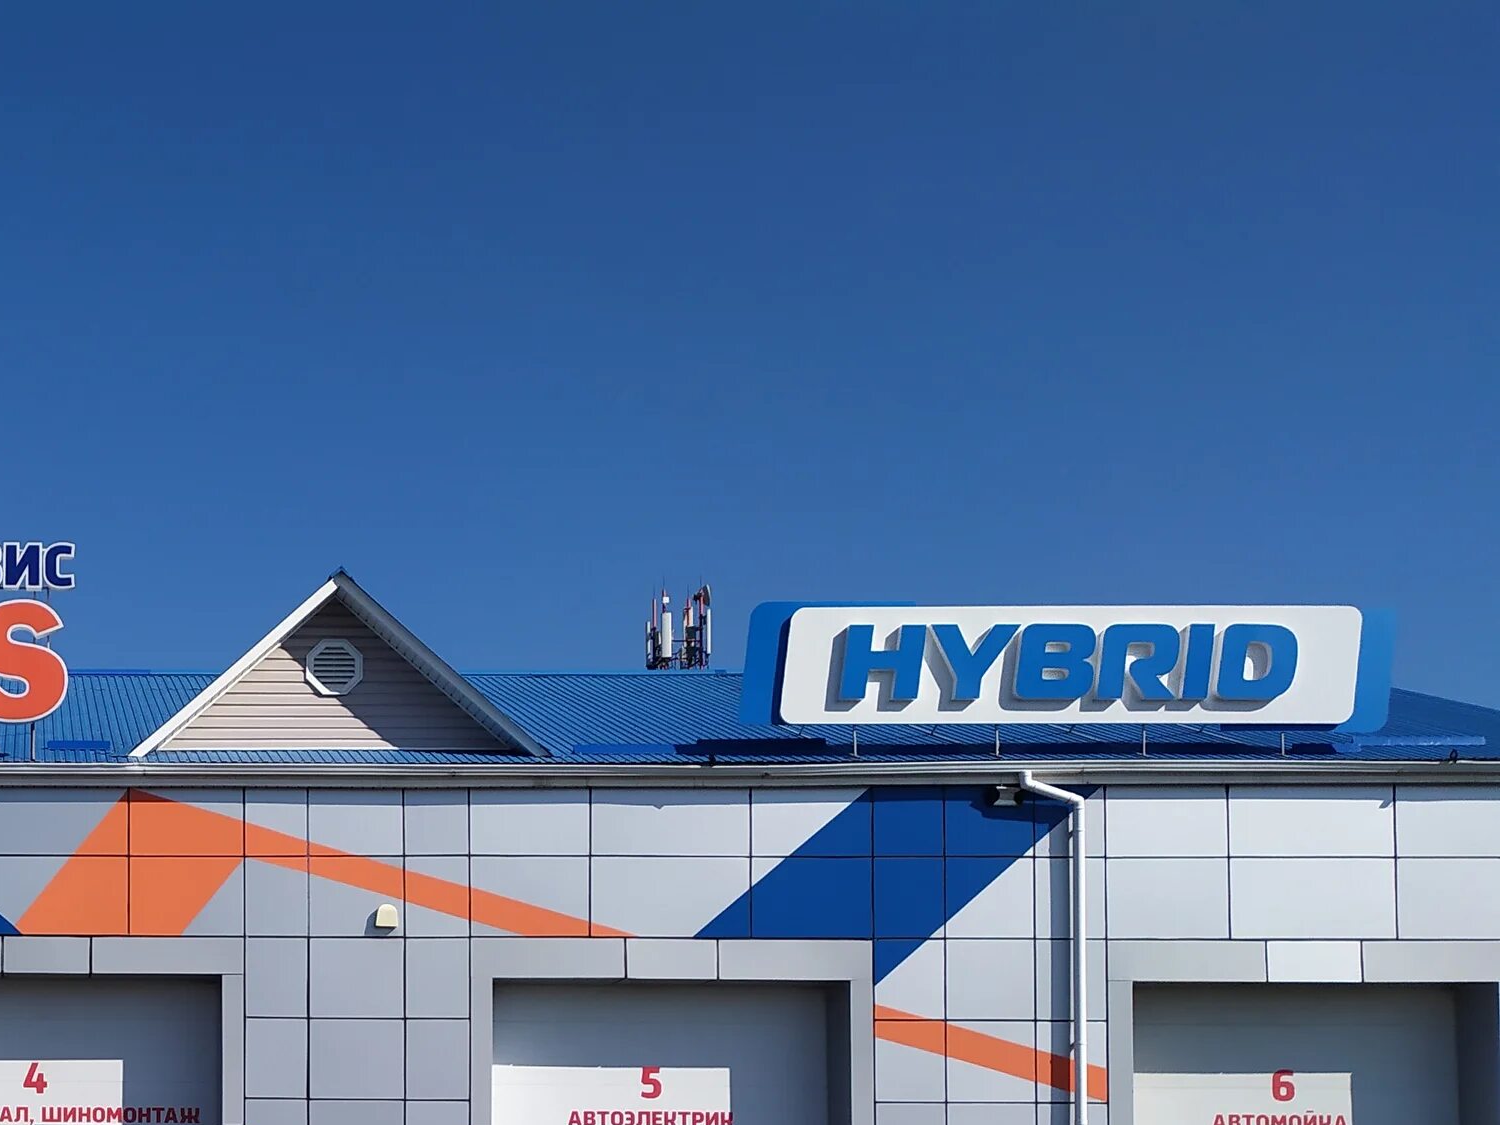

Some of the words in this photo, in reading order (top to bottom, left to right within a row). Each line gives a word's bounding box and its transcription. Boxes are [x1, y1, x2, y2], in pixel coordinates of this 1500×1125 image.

[828, 622, 1299, 708] HYBRID
[22, 1062, 48, 1094] 4
[640, 1066, 663, 1099] 5
[1271, 1069, 1296, 1102] 6
[41, 1106, 201, 1125] ШИНОМОНТАЖ
